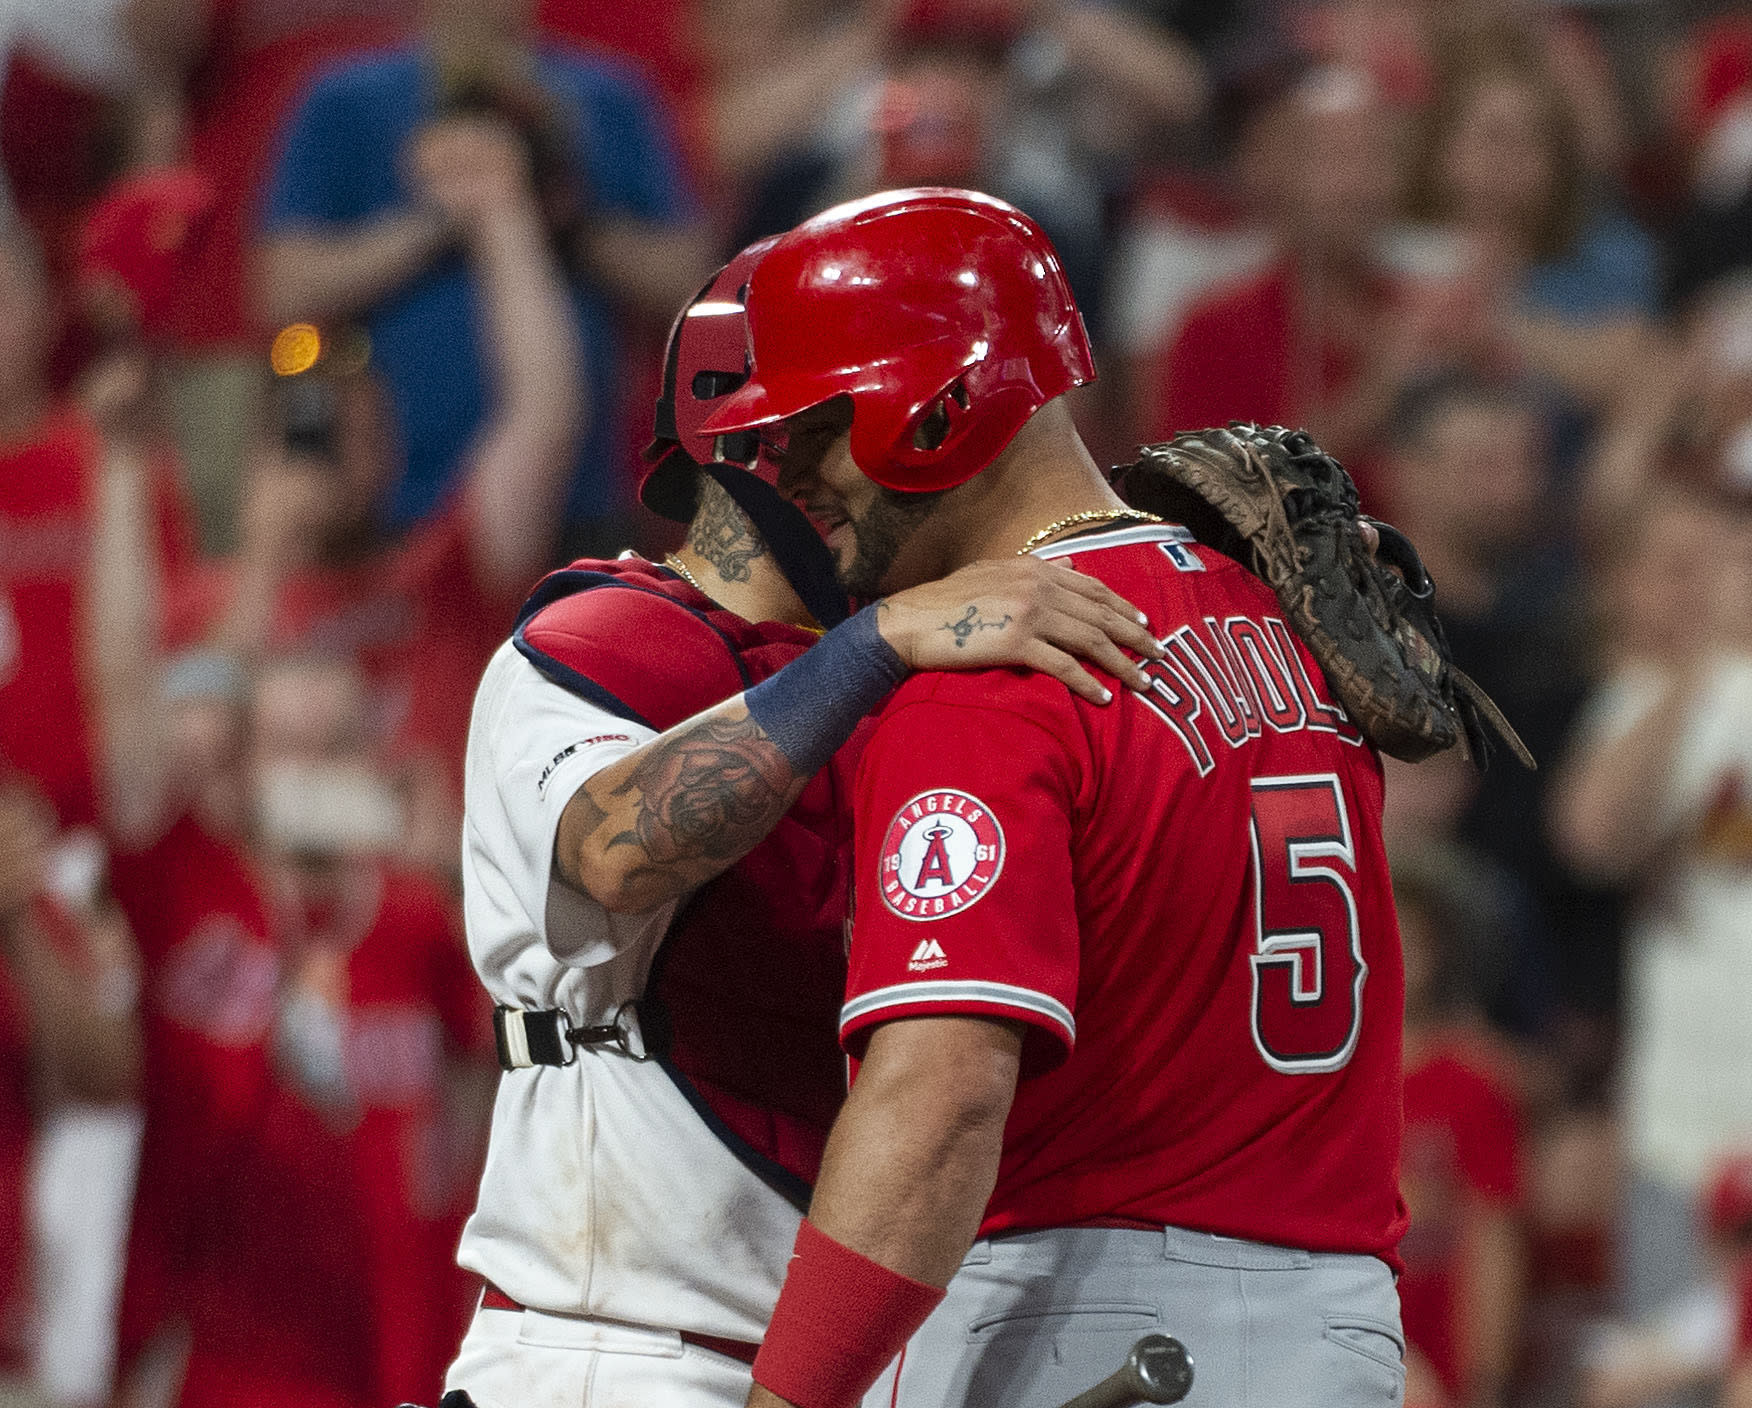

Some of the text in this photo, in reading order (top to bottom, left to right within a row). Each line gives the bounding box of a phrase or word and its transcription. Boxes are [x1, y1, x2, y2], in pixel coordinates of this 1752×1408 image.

[900, 796, 983, 829] ANGELS
[883, 843, 997, 873] 19 61
[914, 831, 955, 889] A
[885, 874, 989, 915] BASEBALL
[1249, 772, 1369, 1076] 5
